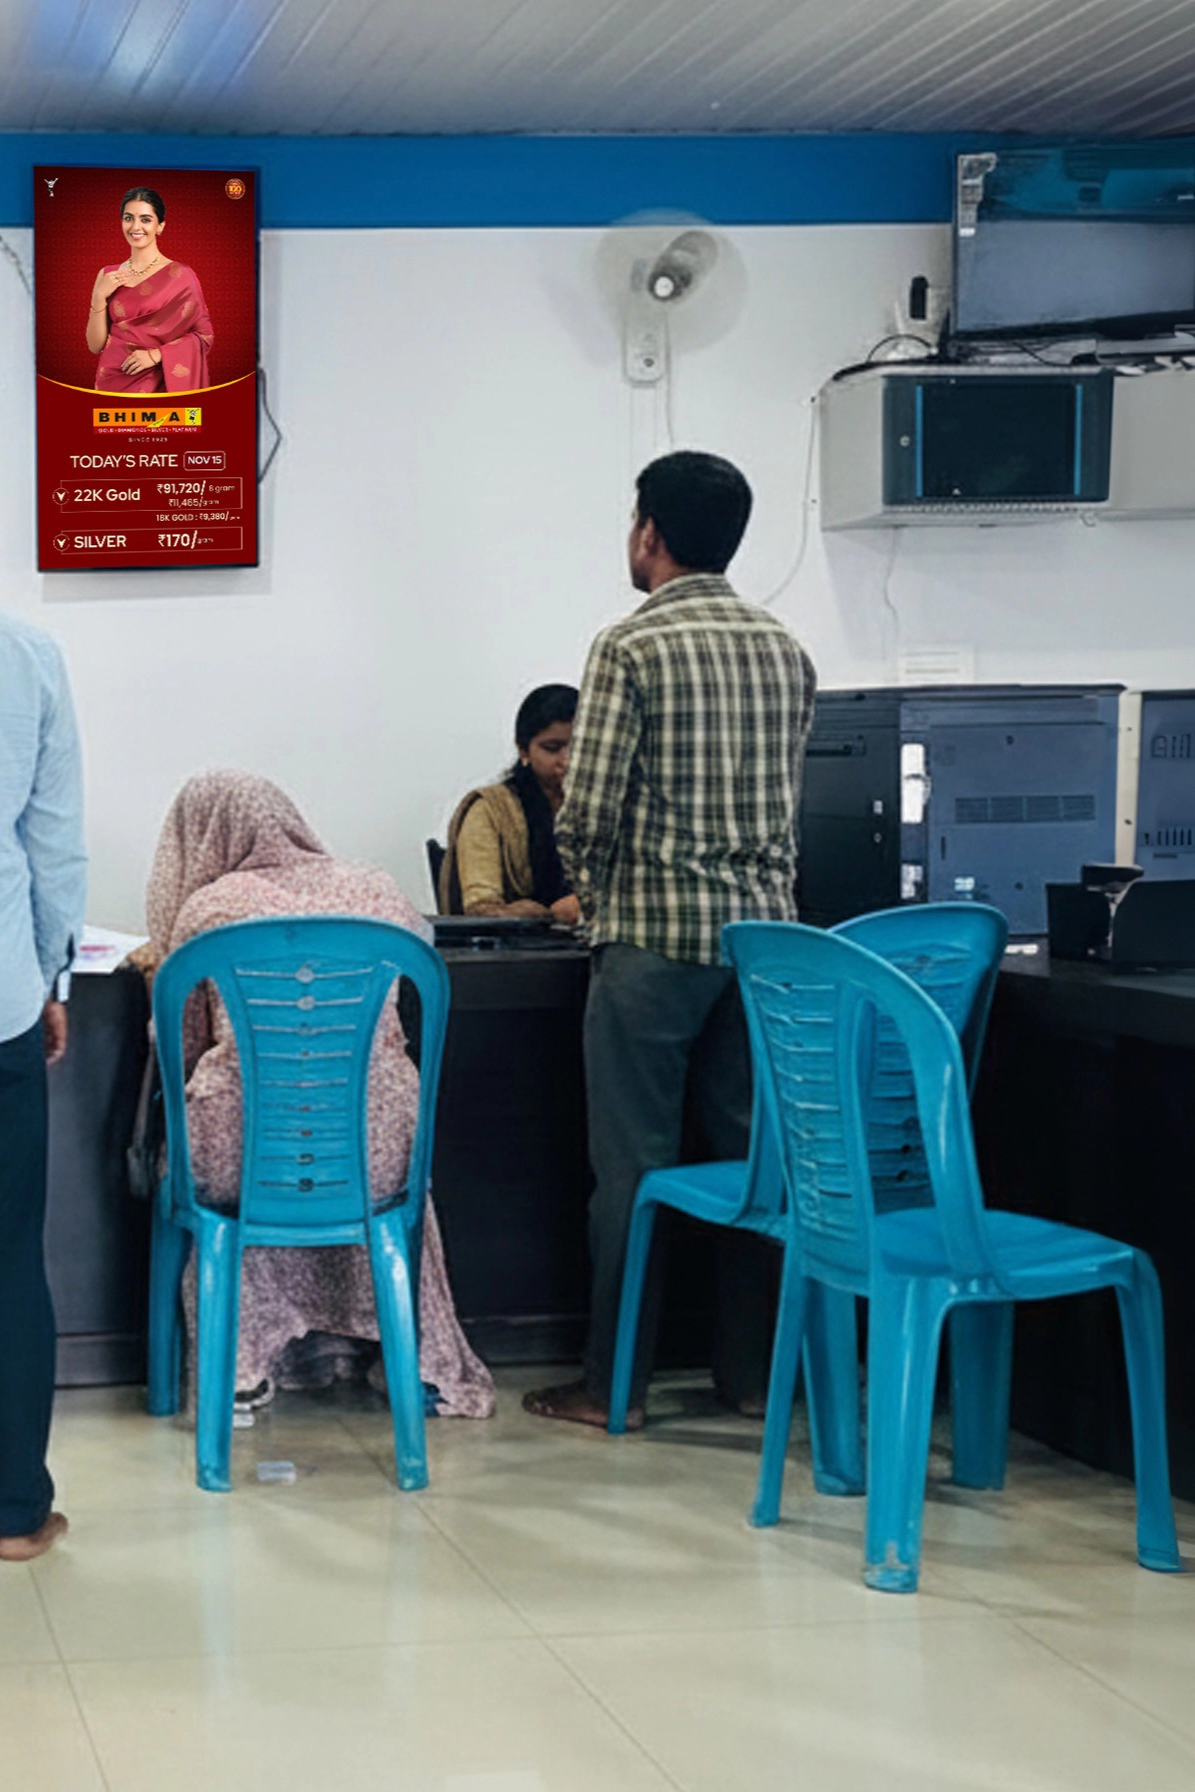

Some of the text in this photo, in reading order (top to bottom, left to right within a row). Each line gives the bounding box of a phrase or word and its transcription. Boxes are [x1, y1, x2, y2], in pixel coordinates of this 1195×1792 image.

[99, 412, 180, 422] BHIMA
[70, 454, 179, 468] TODAY'S RATE
[187, 456, 222, 465] NOV 15
[74, 488, 141, 502] 22K Gold
[74, 535, 127, 548] SILVER
